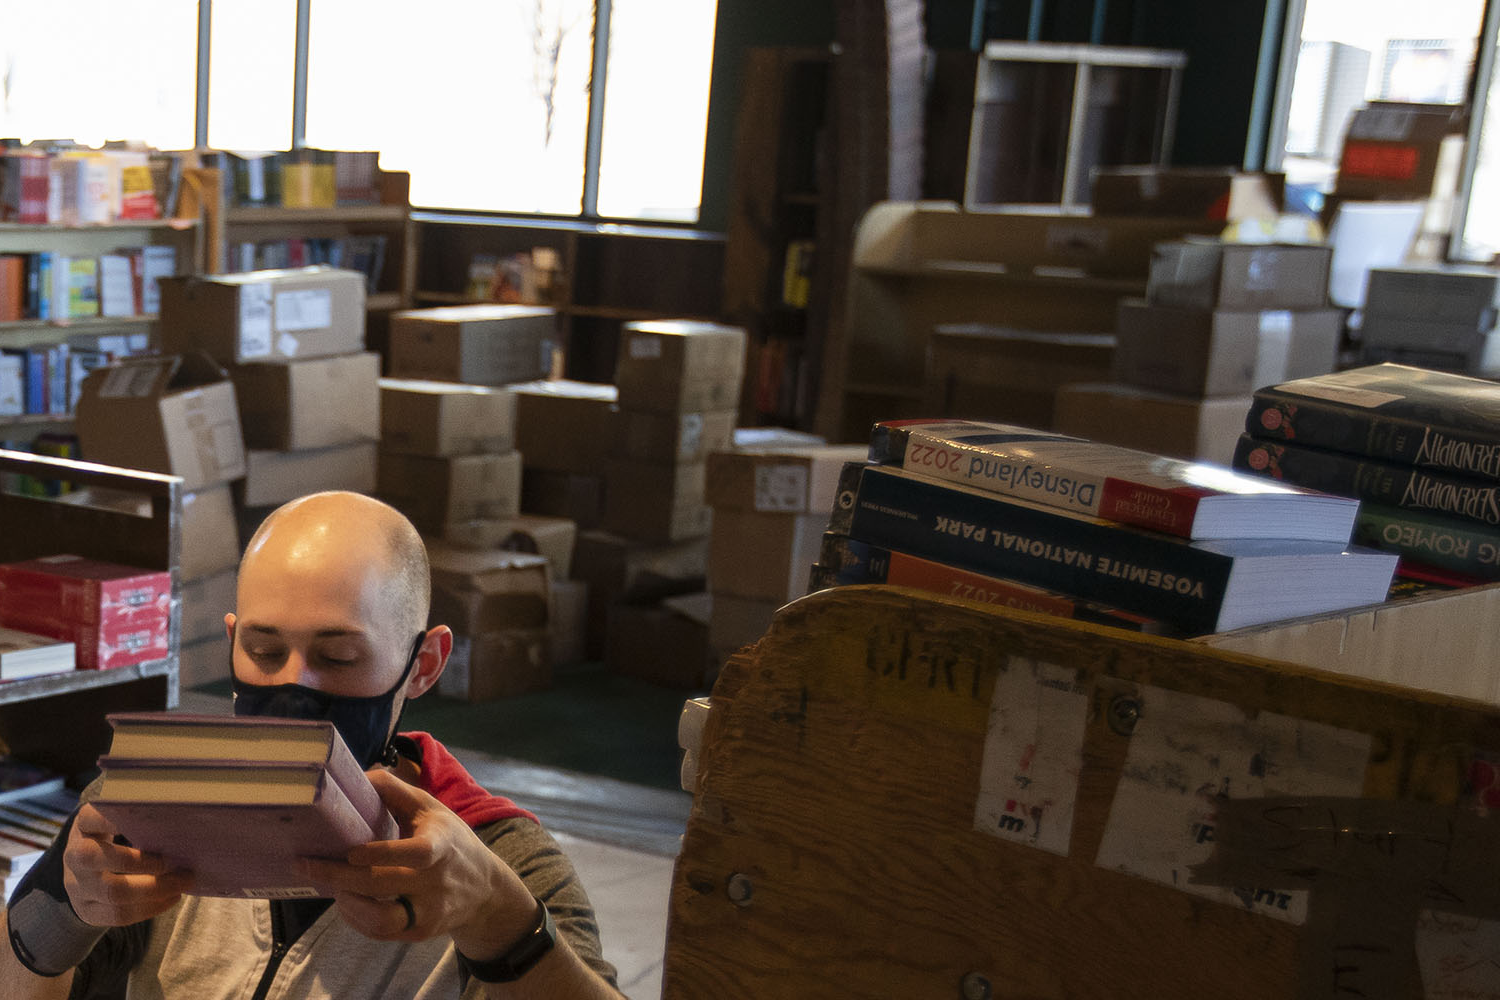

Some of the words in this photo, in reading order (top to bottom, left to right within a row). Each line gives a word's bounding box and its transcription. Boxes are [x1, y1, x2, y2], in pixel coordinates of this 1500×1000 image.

[908, 441, 964, 474] 2022
[968, 454, 1097, 509] Disneyland
[930, 514, 990, 545] PARK
[989, 527, 1095, 570] NATIONAL
[1381, 523, 1470, 560] ROMEO
[1096, 555, 1206, 599] YOSEMITE
